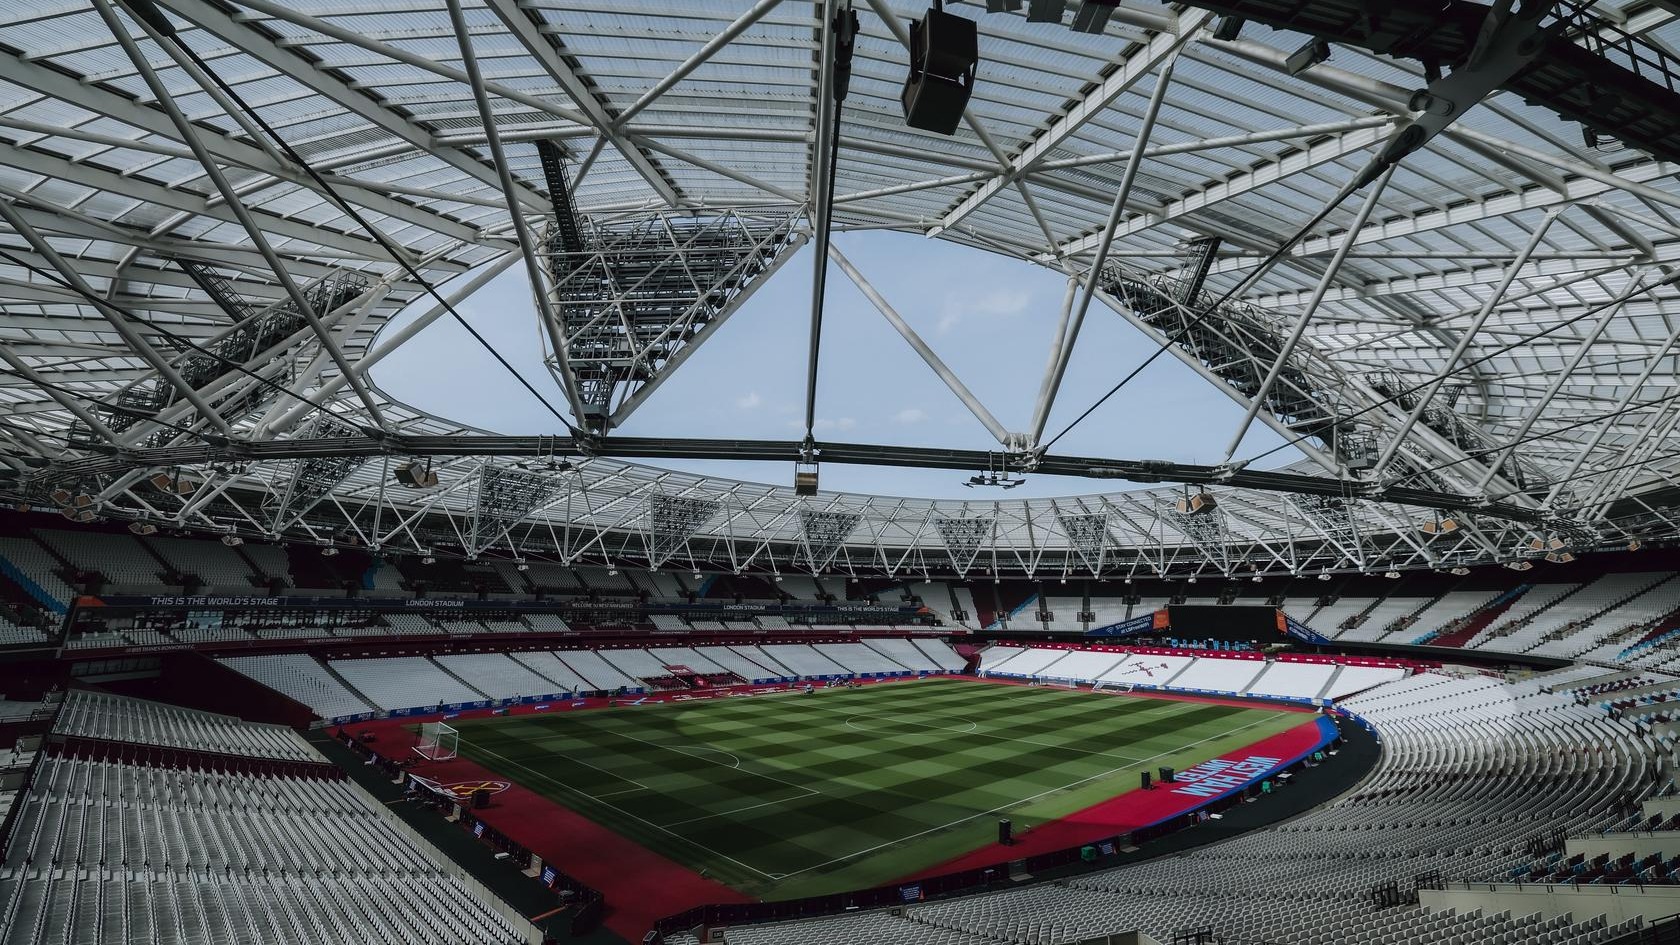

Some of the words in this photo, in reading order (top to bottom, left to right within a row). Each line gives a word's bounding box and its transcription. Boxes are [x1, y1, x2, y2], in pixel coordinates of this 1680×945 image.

[151, 597, 174, 605] THIS
[207, 597, 249, 605] WORLD'S
[1173, 759, 1239, 783] UNITED
[1224, 756, 1282, 778] WEST
[1169, 773, 1251, 797] HAM
